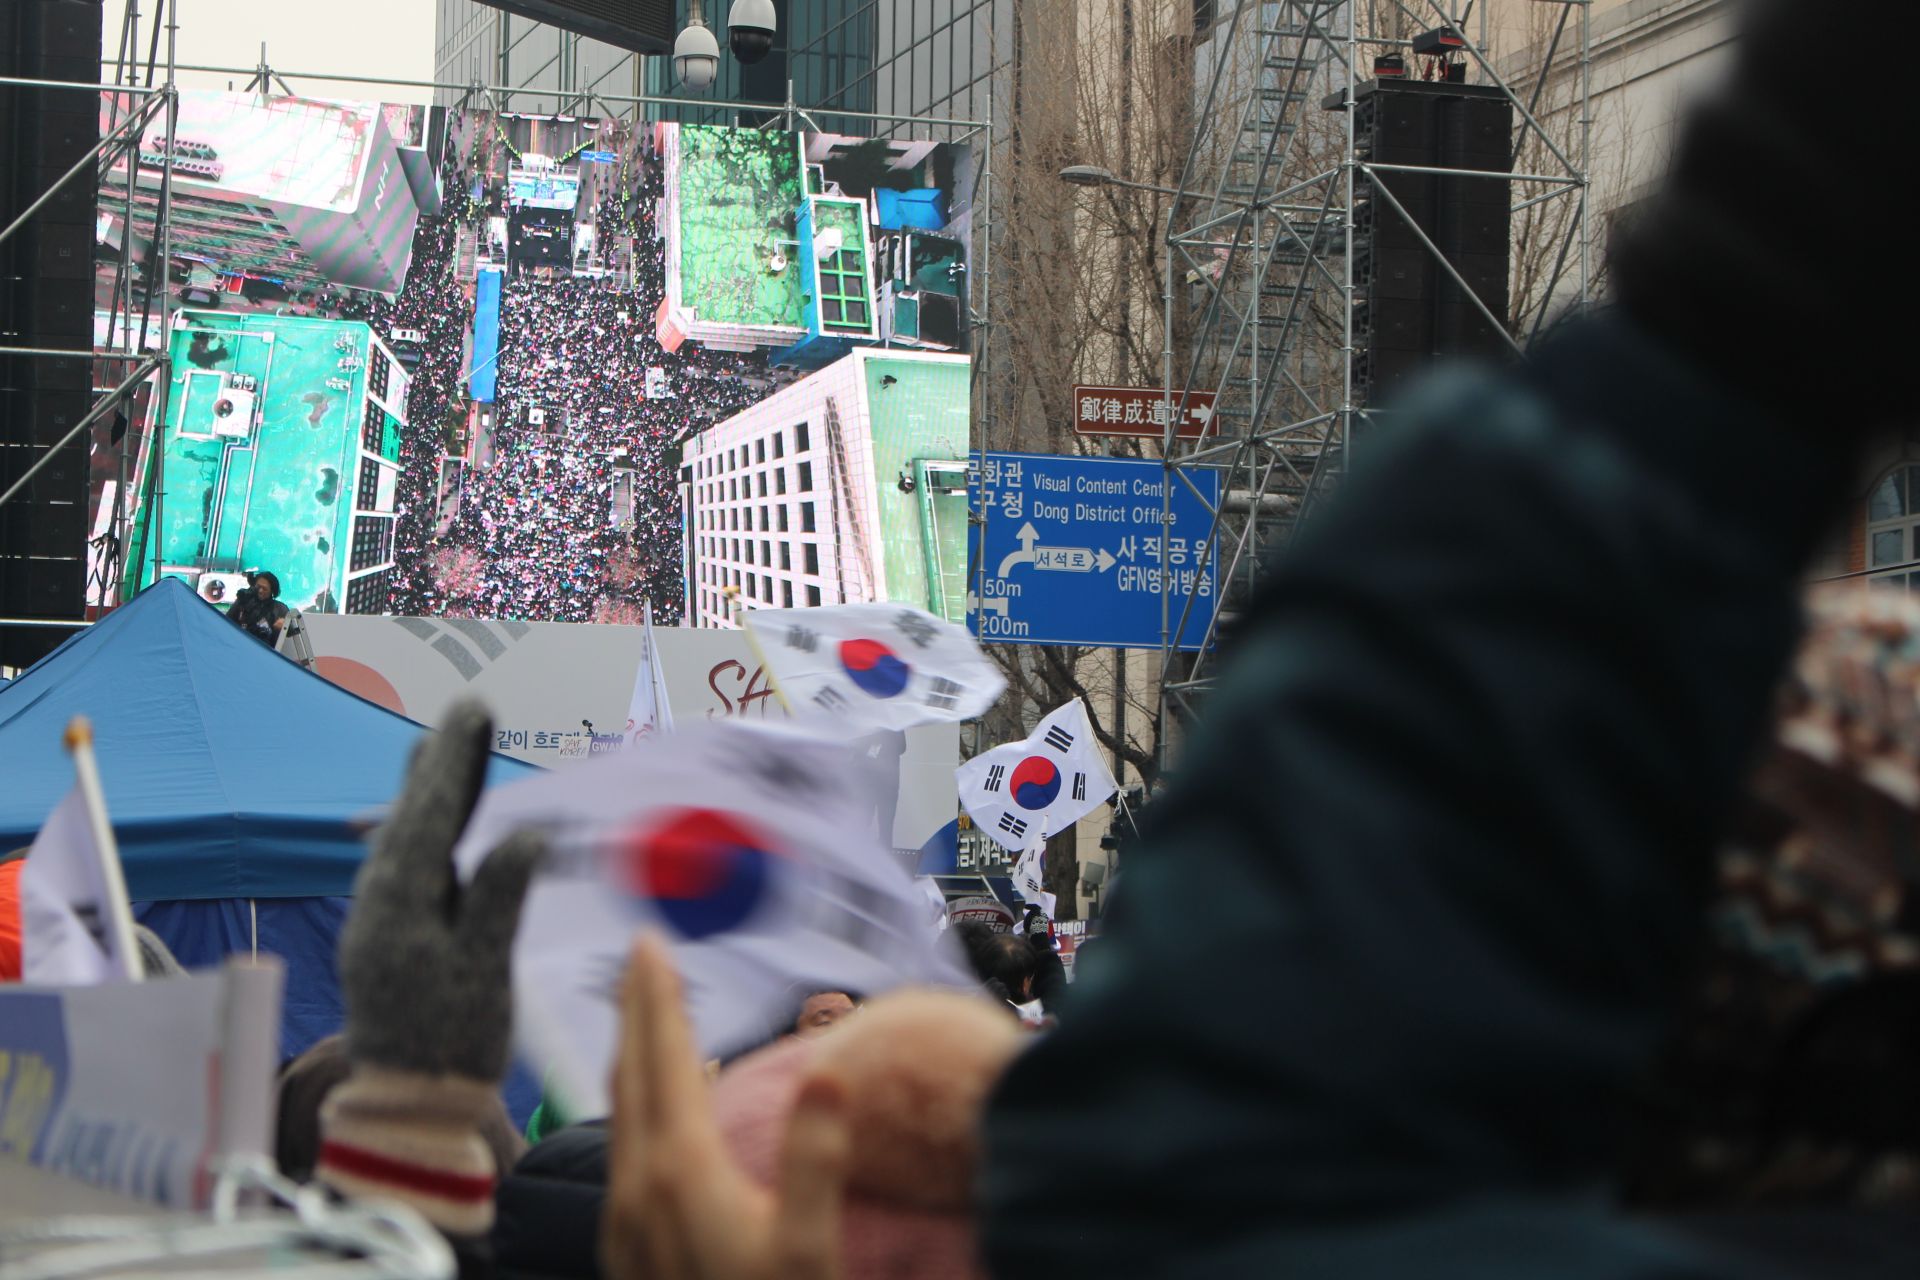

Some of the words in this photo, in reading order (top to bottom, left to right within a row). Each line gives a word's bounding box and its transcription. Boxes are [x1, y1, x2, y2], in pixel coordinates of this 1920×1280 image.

[1033, 473, 1070, 492] Visual
[1076, 476, 1127, 495] Content
[1133, 479, 1176, 498] Centr
[1034, 501, 1069, 524] Dong
[1076, 503, 1126, 522] District
[1133, 507, 1176, 526] Office
[1036, 551, 1086, 567] 서석로
[1116, 535, 1212, 566] 사직공원
[985, 579, 1022, 597] 50m
[496, 730, 528, 750] 같이
